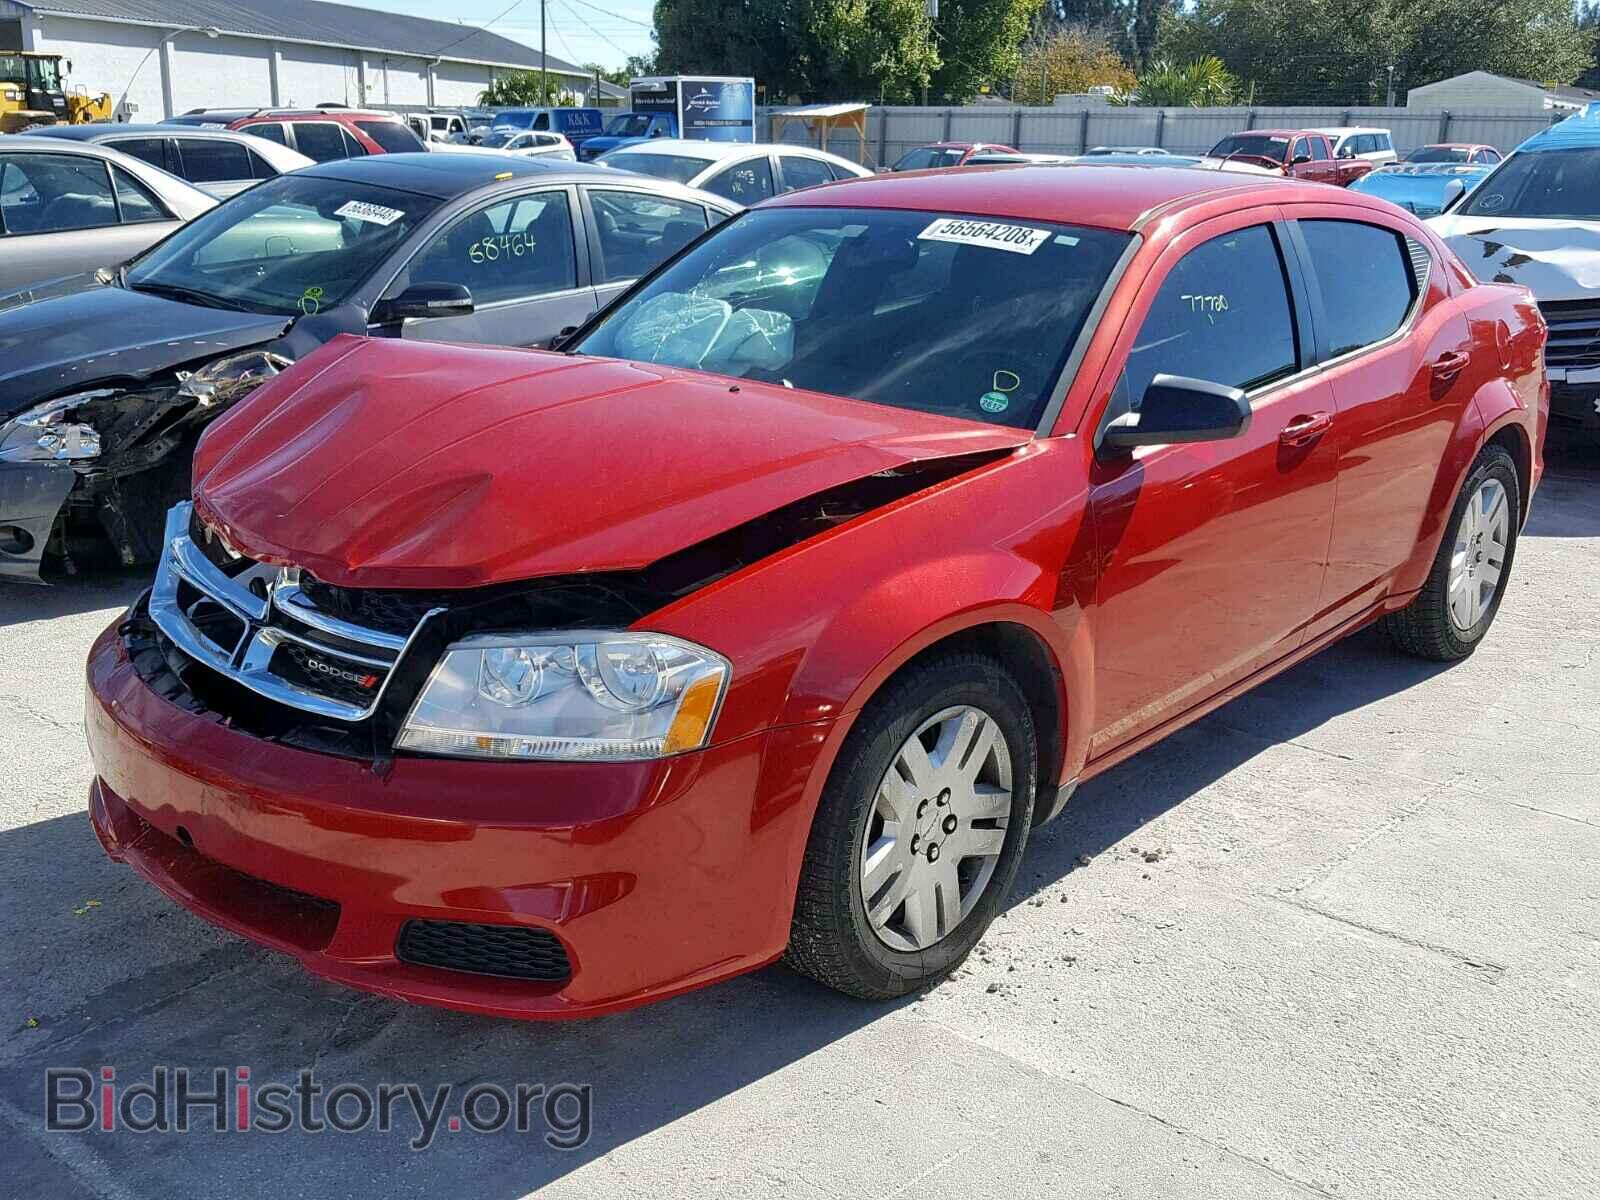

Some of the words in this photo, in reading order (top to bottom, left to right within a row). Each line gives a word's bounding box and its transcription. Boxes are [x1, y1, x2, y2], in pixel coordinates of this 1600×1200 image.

[568, 111, 591, 126] K&K
[993, 370, 1020, 391] D
[308, 659, 367, 684] DODGE
